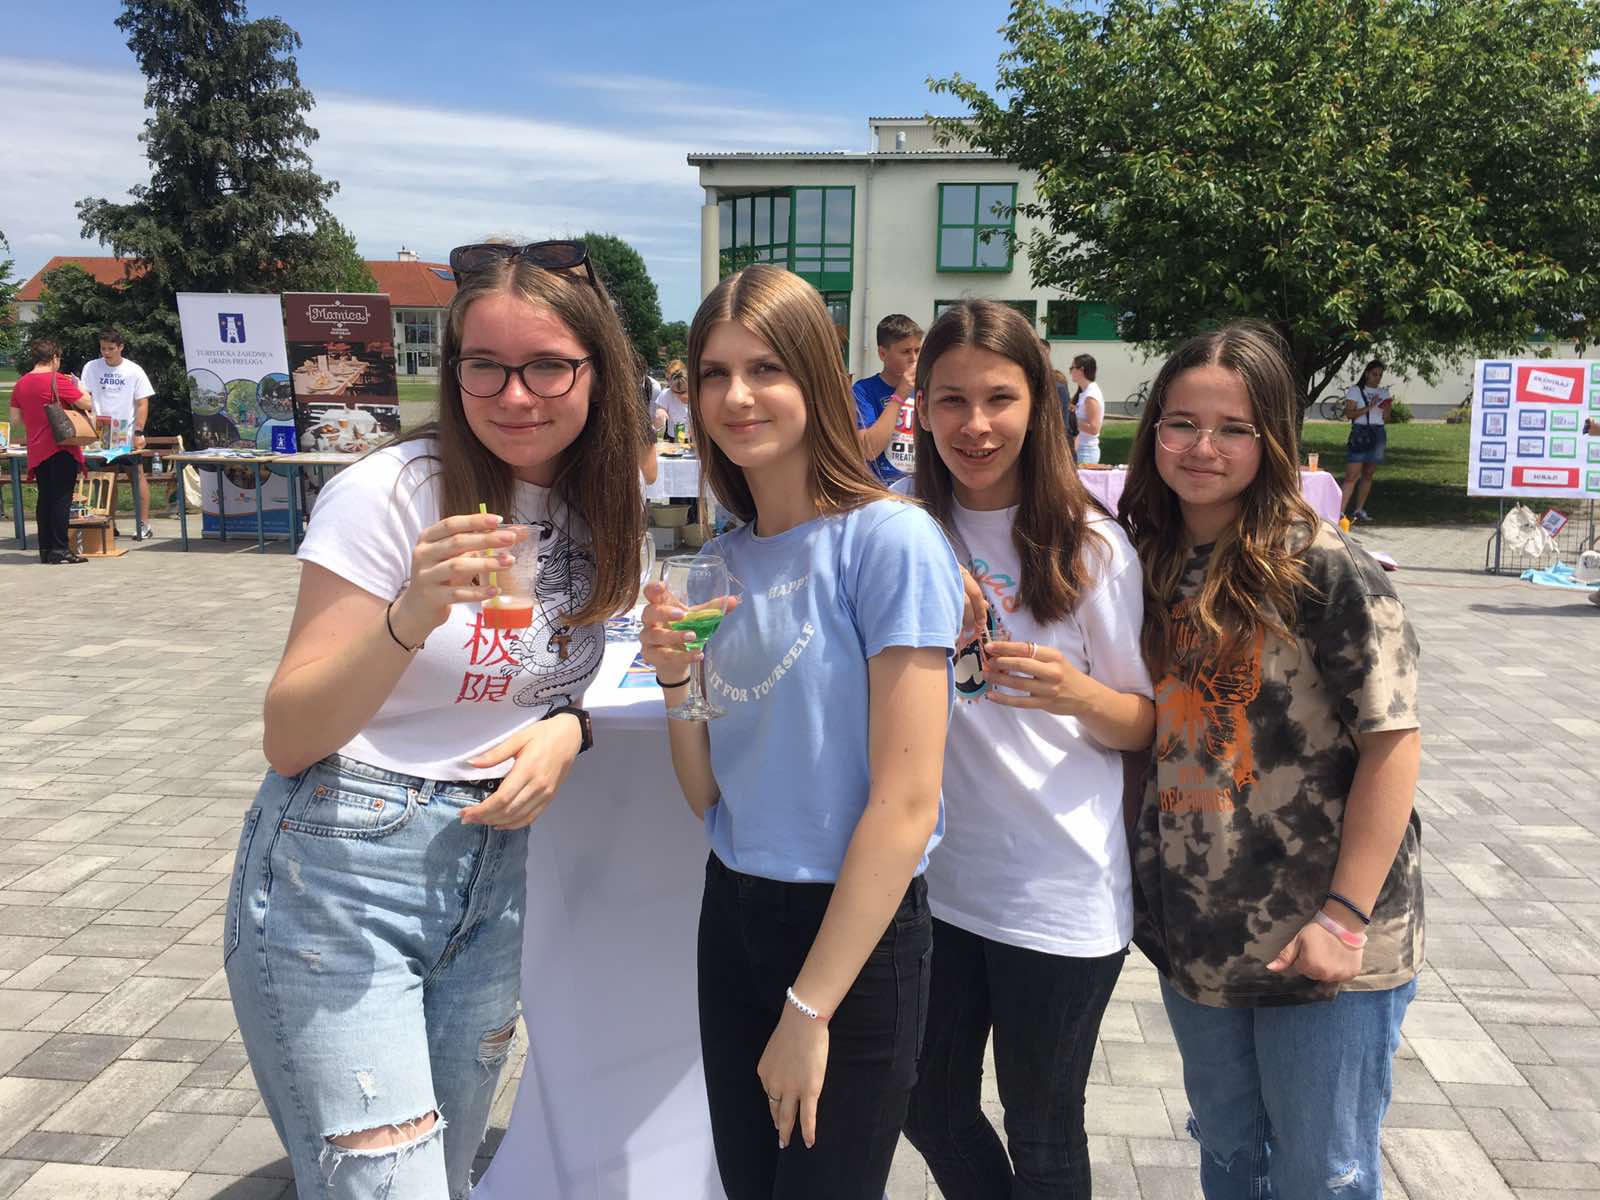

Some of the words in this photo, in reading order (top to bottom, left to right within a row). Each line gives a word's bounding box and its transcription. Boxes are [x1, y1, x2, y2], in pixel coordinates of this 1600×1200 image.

[311, 308, 366, 320] Mamica
[100, 377, 125, 386] ZABOK
[723, 683, 749, 702] FOR
[750, 621, 816, 701] YOURSELF
